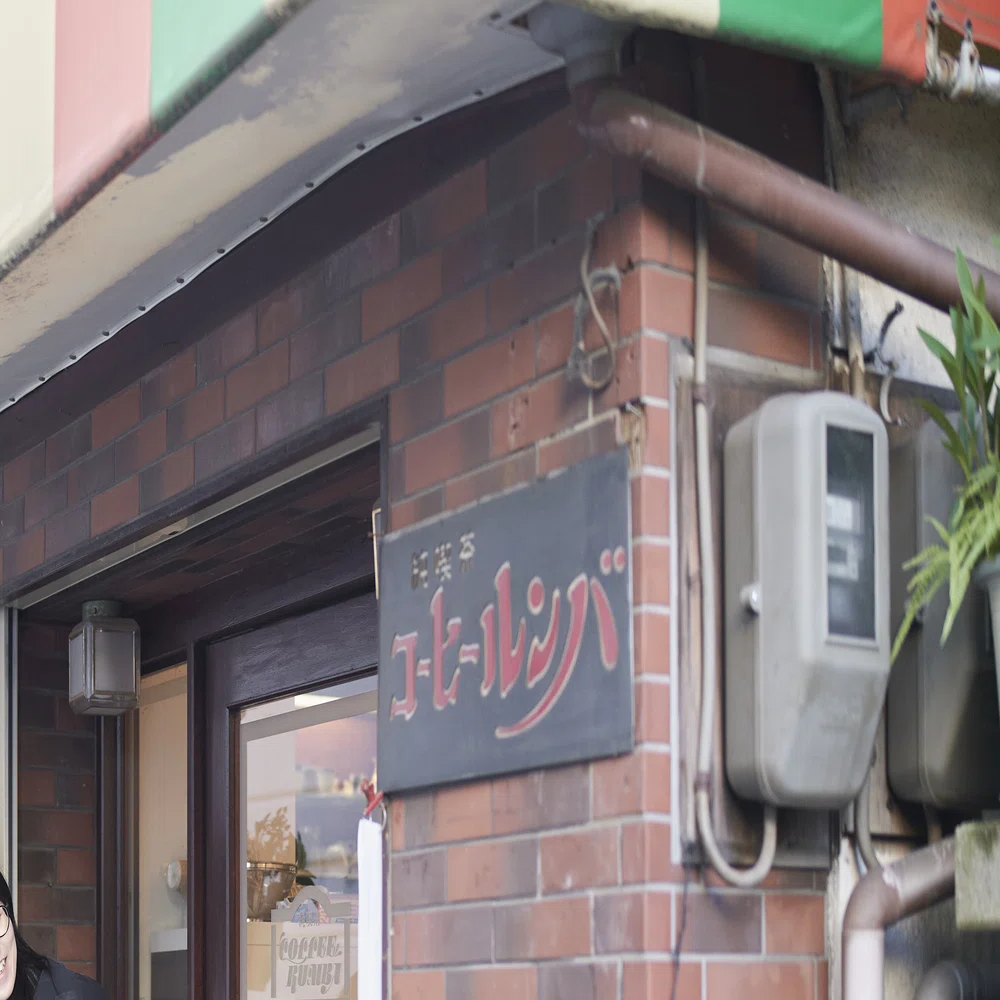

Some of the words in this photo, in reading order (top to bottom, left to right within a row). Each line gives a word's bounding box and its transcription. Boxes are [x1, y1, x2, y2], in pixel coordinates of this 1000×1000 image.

[390, 545, 627, 739] コーヒールンバ
[279, 931, 342, 964] COFFEE
[286, 962, 342, 994] RUMBA
